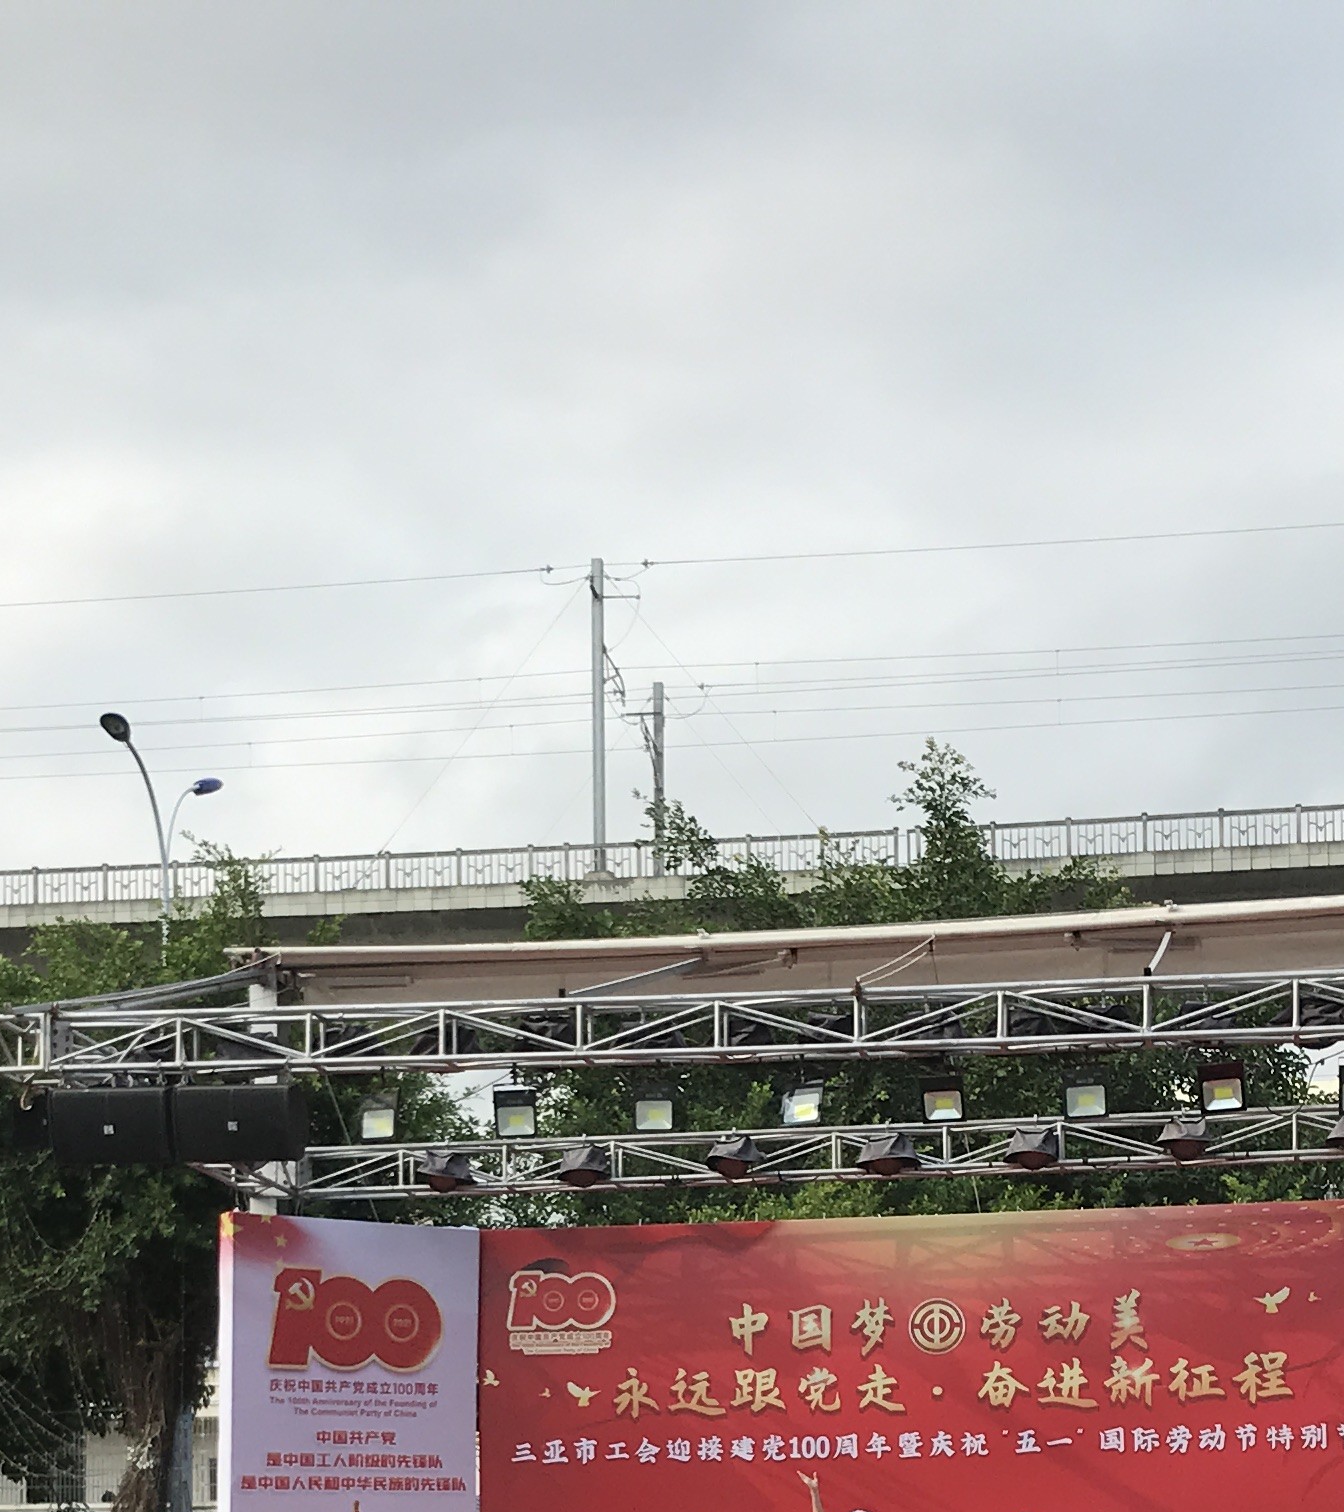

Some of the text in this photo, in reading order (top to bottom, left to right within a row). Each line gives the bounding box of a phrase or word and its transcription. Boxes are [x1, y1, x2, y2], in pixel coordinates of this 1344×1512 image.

[267, 1266, 444, 1371] 100
[729, 1289, 1149, 1356] 中国梦 劳动美
[269, 1378, 439, 1396] 庆祝中国共产党成立100周年
[316, 1430, 397, 1445] 中国共产党
[266, 1452, 443, 1469] 是中国工人阶级的先锋队
[240, 1475, 467, 1492] 是中国人民和中华民族的先锋队
